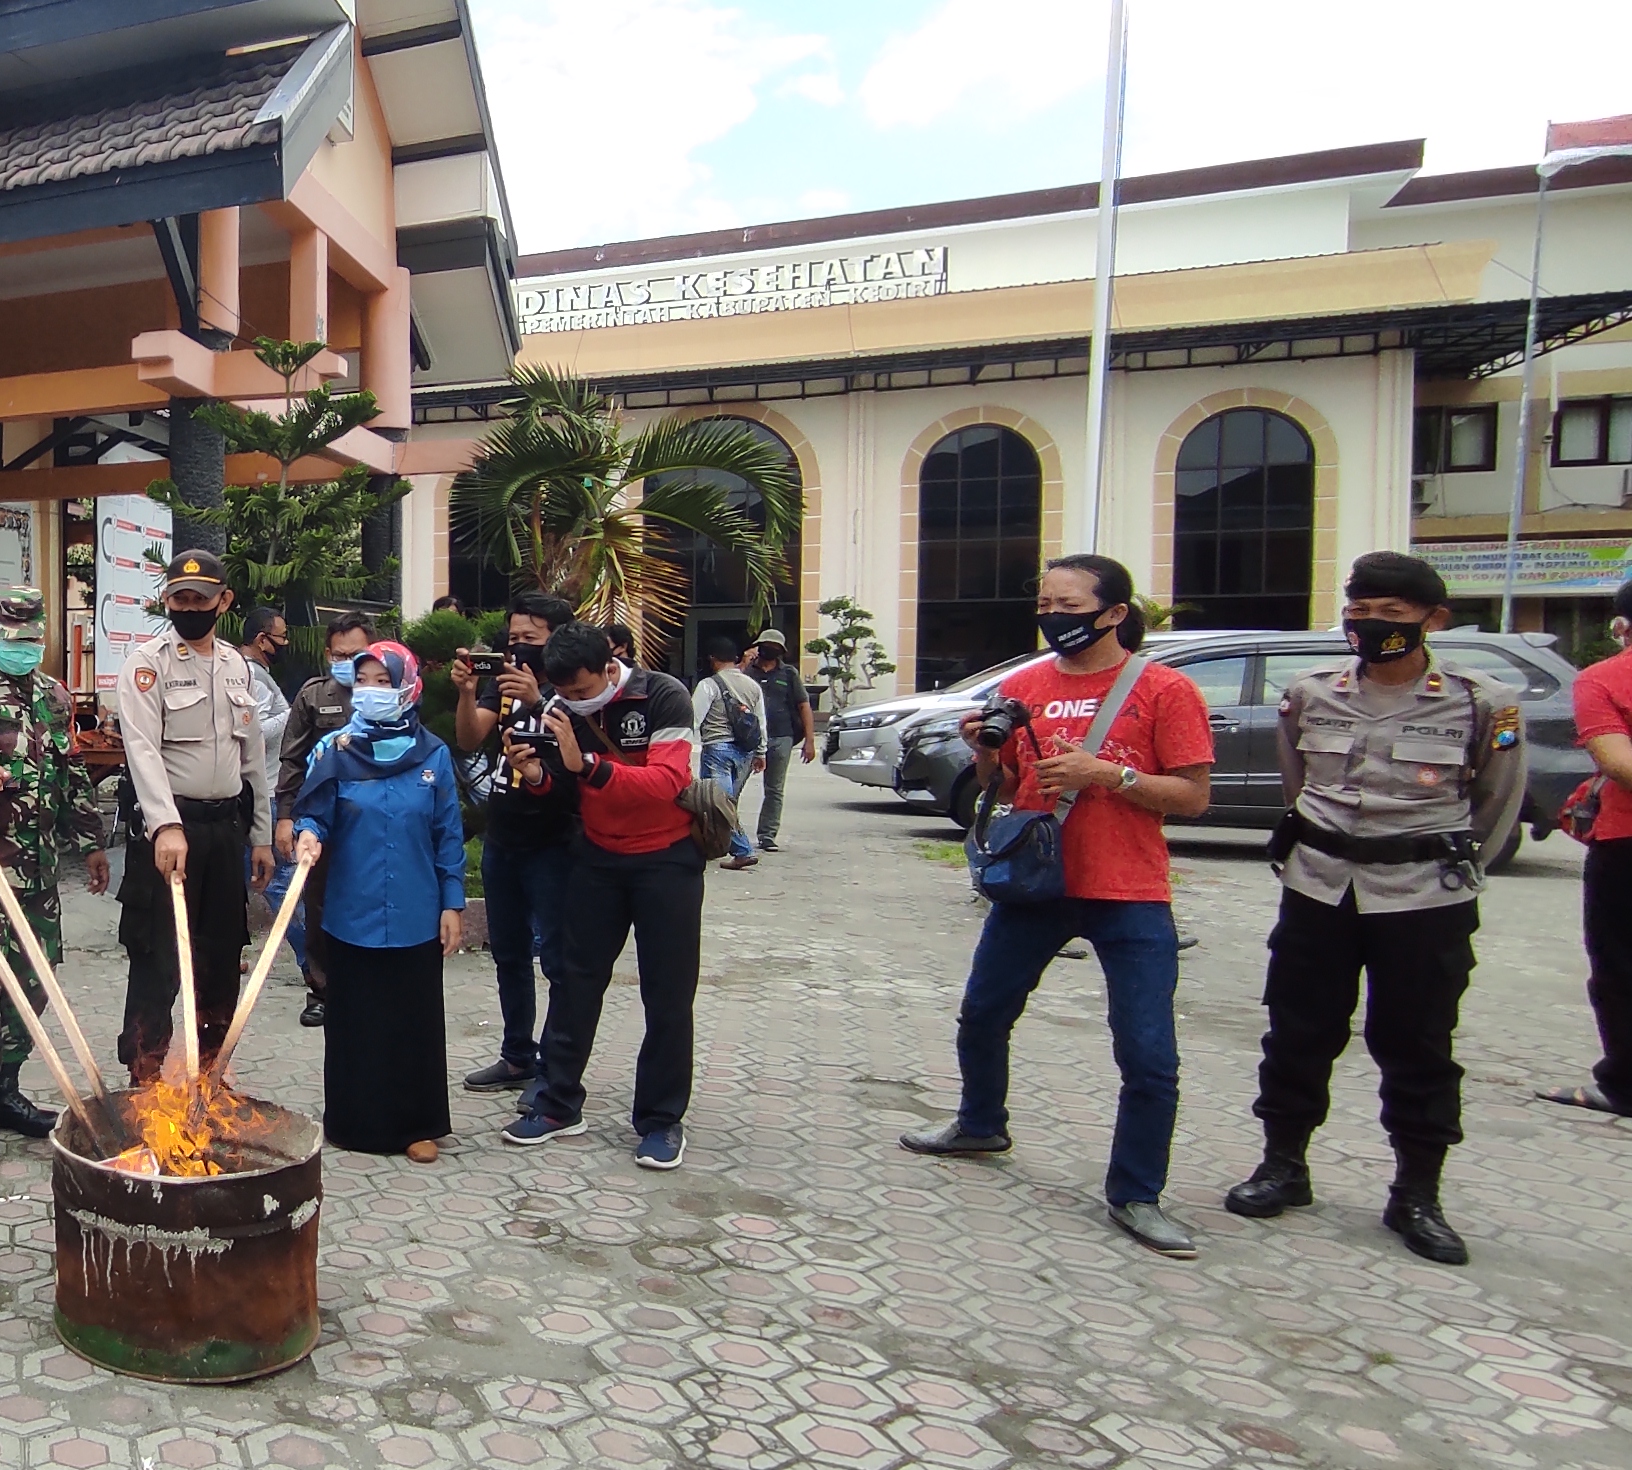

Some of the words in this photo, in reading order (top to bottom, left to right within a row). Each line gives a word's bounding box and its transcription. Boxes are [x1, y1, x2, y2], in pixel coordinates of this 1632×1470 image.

[517, 279, 653, 317] DINAS
[680, 247, 948, 302] KESEHATAN
[524, 304, 670, 335] PEMERINTAH
[685, 289, 832, 320] KABUPATEN
[852, 272, 946, 304] KEDIRI
[1402, 725, 1464, 739] POLRI
